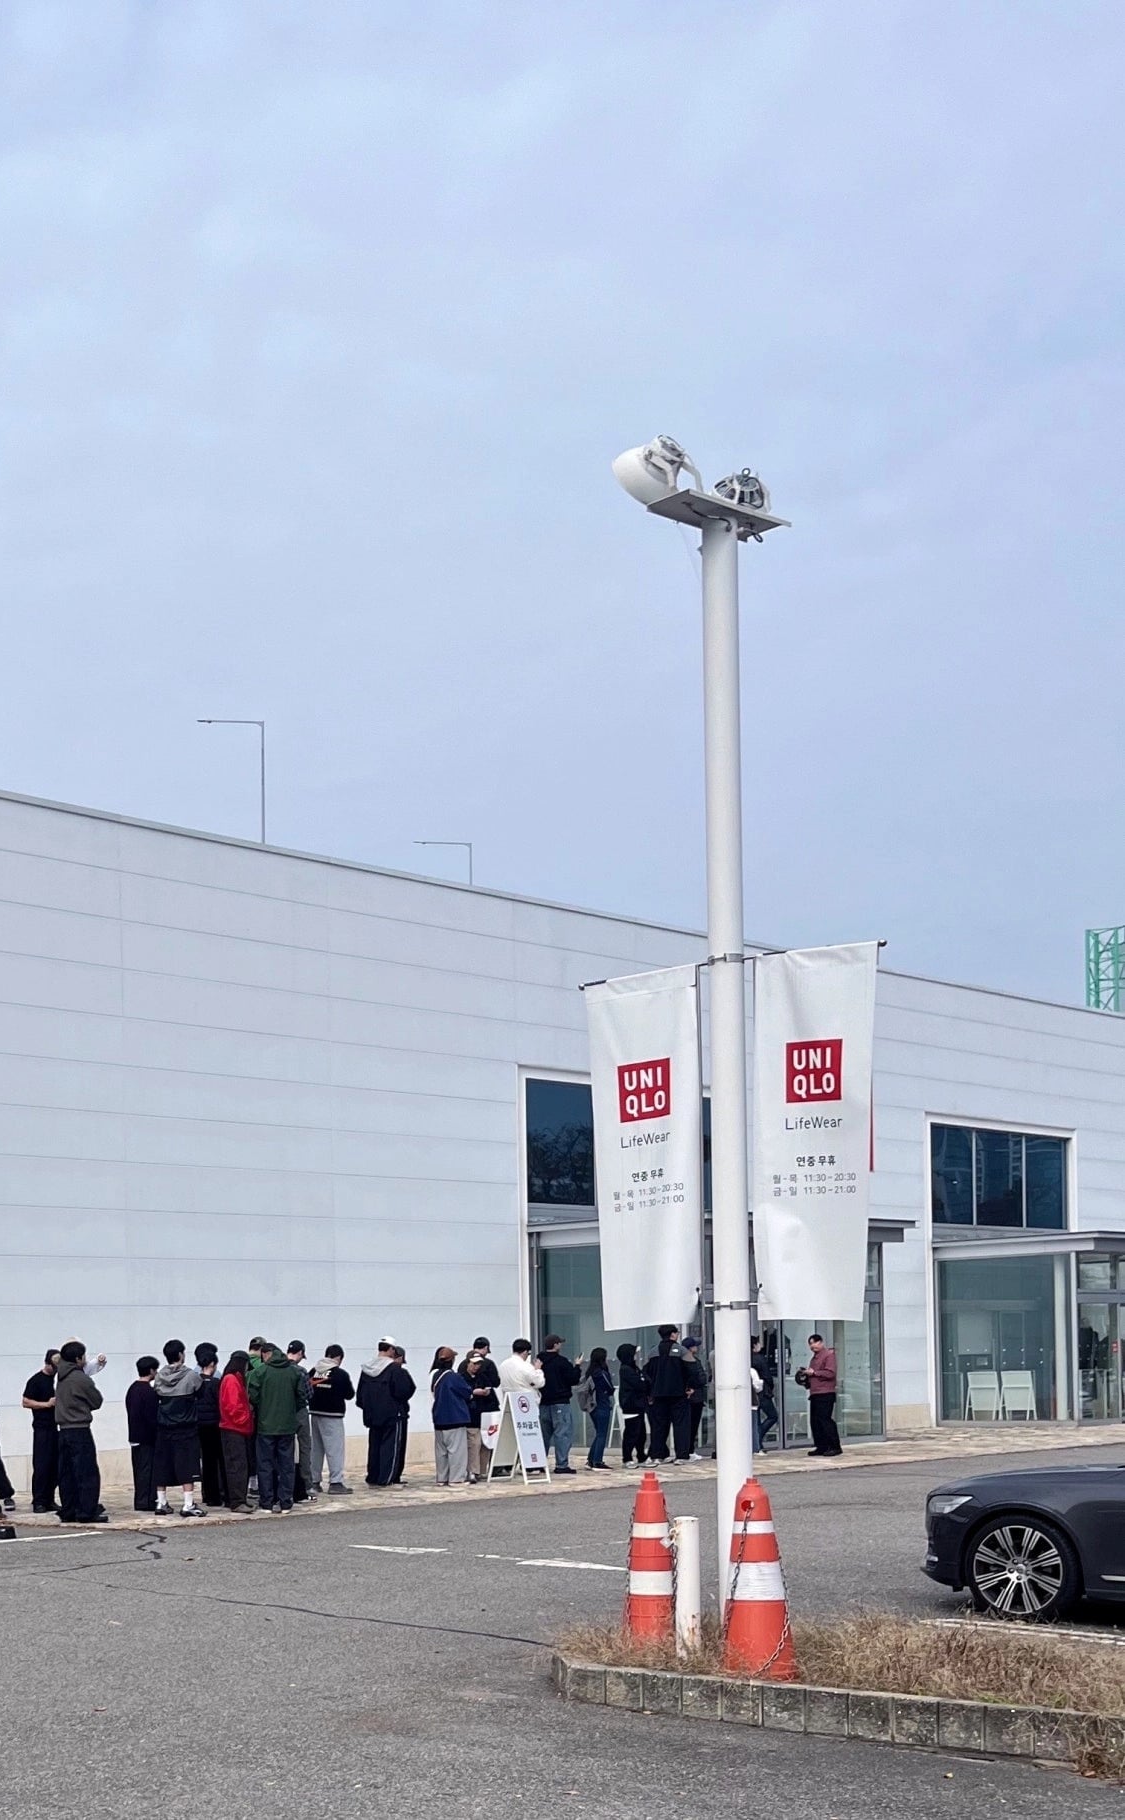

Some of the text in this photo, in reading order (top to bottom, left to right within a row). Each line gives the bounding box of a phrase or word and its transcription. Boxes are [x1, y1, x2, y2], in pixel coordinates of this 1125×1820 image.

[792, 1046, 832, 1070] UNI
[623, 1066, 663, 1091] UNI
[793, 1072, 835, 1099] QLO
[625, 1090, 666, 1118] QLO
[785, 1116, 843, 1130] LifeWear
[620, 1131, 671, 1149] LifeWear
